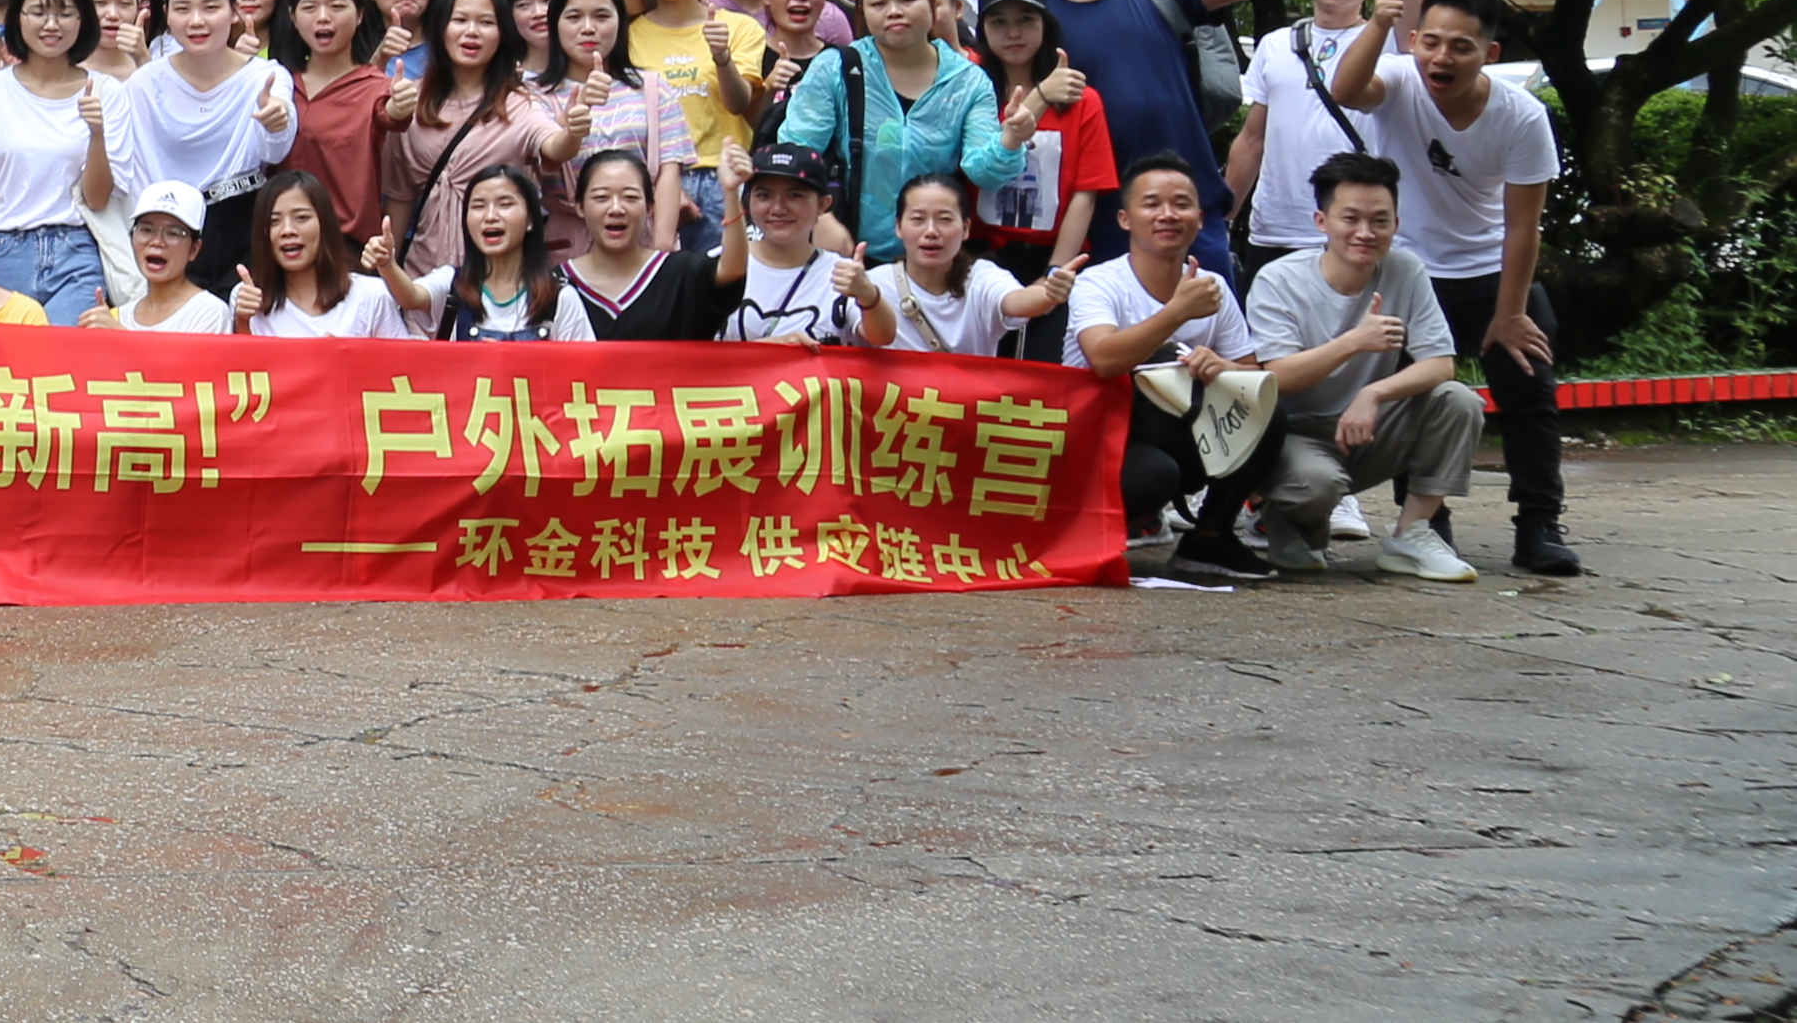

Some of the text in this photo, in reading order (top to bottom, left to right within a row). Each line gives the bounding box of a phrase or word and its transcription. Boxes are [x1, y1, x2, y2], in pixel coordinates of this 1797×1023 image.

[361, 375, 1068, 521] 户外拓展训练营
[455, 517, 721, 580] 环金科技
